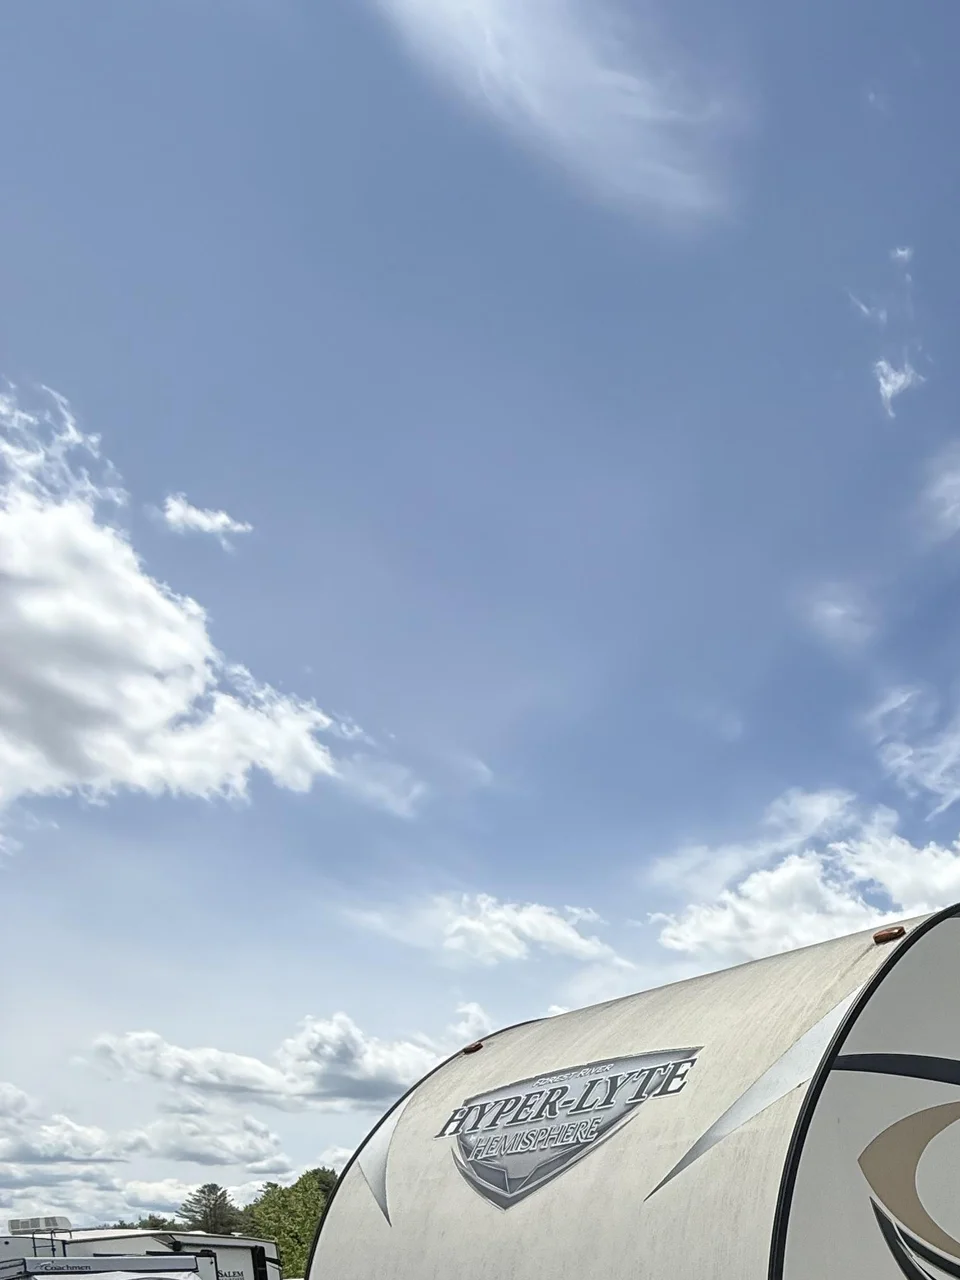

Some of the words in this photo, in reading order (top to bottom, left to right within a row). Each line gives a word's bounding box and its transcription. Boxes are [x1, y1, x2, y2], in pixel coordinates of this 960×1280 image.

[532, 1071, 578, 1088] FOREST
[576, 1064, 614, 1079] RIVER
[432, 1057, 698, 1140] HYPER-LYTE
[467, 1117, 601, 1161] HEMISPHERE
[217, 1270, 244, 1278] SALEM
